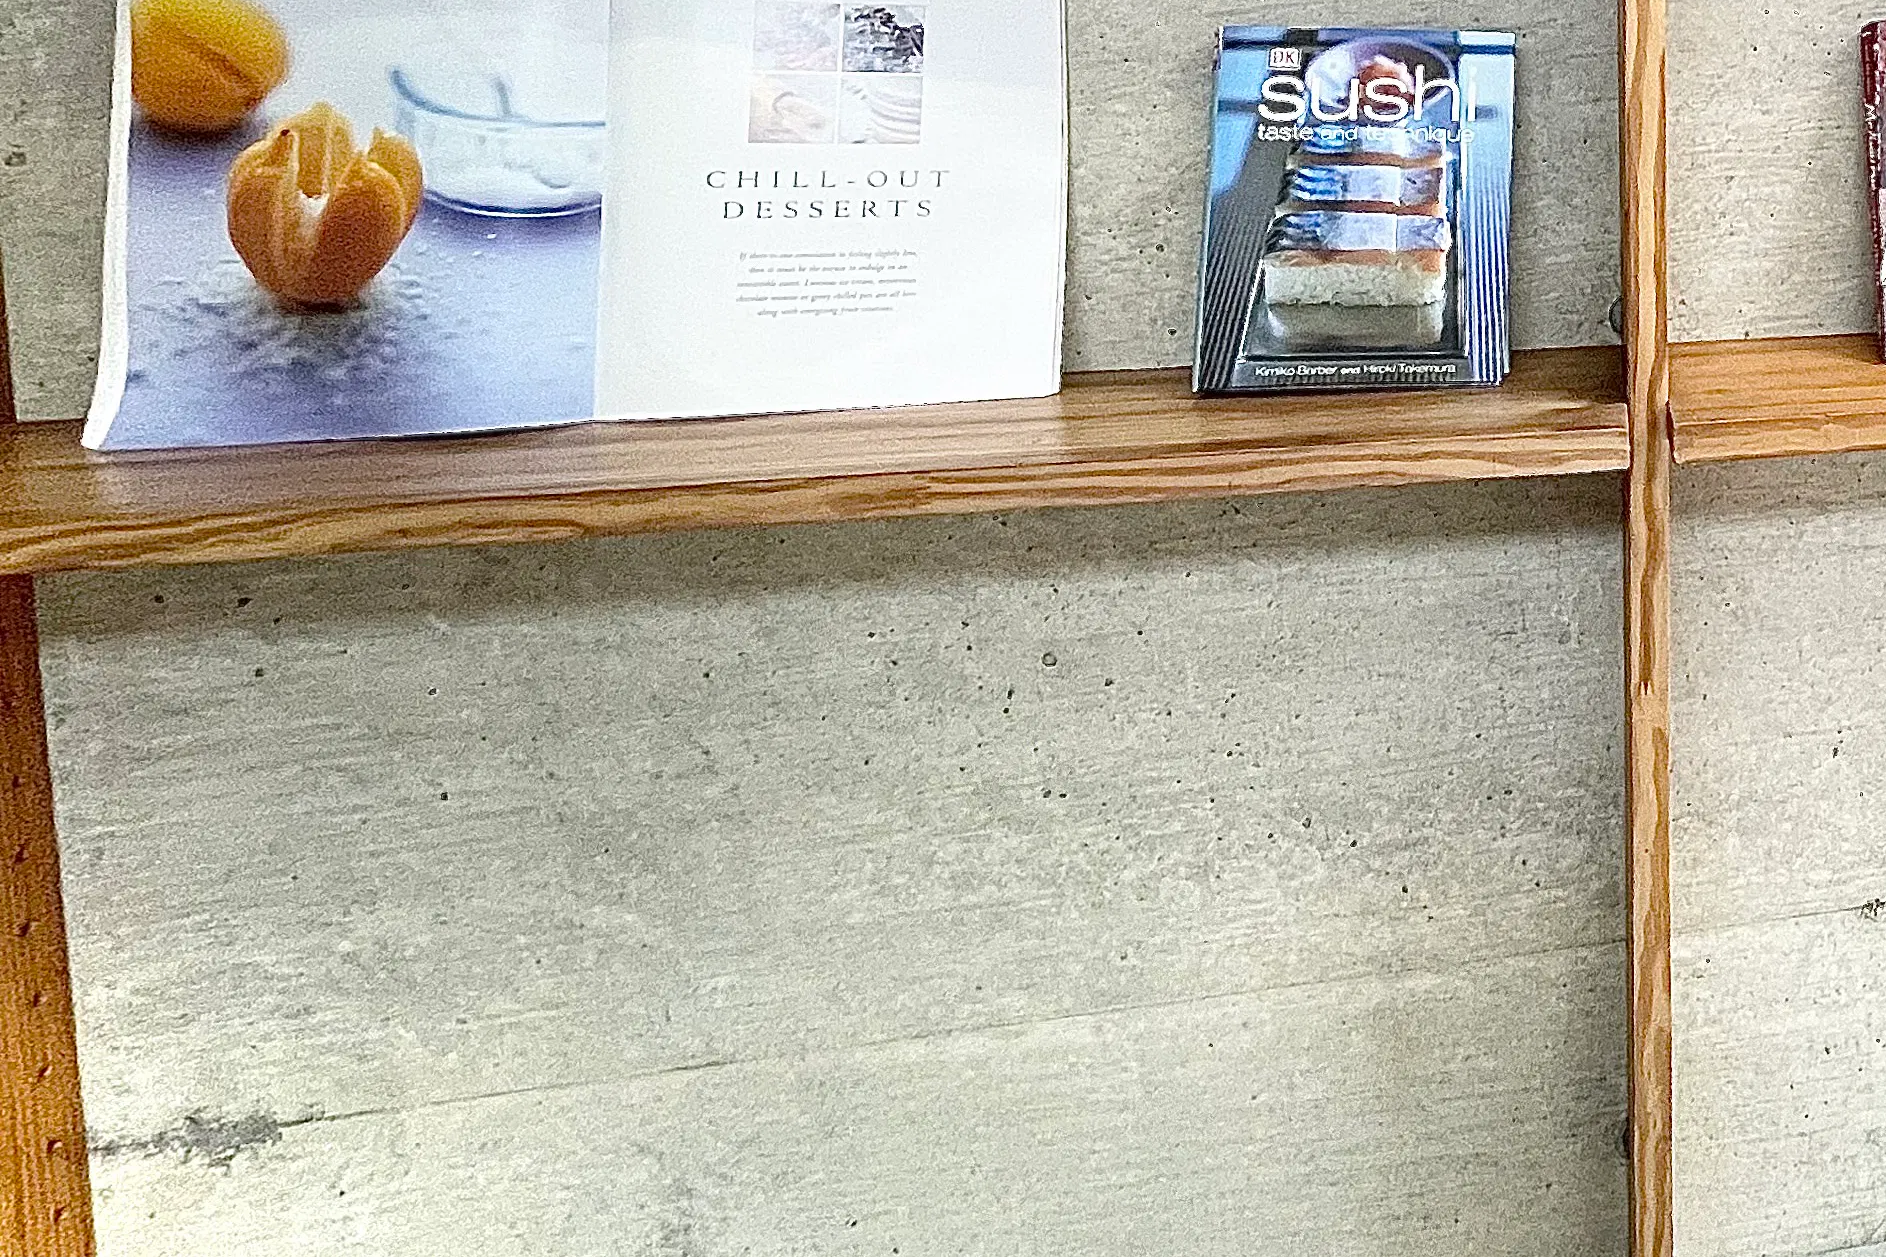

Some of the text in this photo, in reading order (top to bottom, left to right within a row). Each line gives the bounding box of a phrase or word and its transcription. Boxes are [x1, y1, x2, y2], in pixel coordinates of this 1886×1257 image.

[1273, 50, 1296, 66] DK
[1258, 63, 1478, 123] sushi
[1257, 124, 1314, 142] taste
[1320, 124, 1358, 141] and
[706, 169, 951, 189] CHILL-OUT
[722, 199, 932, 220] DESSERTS
